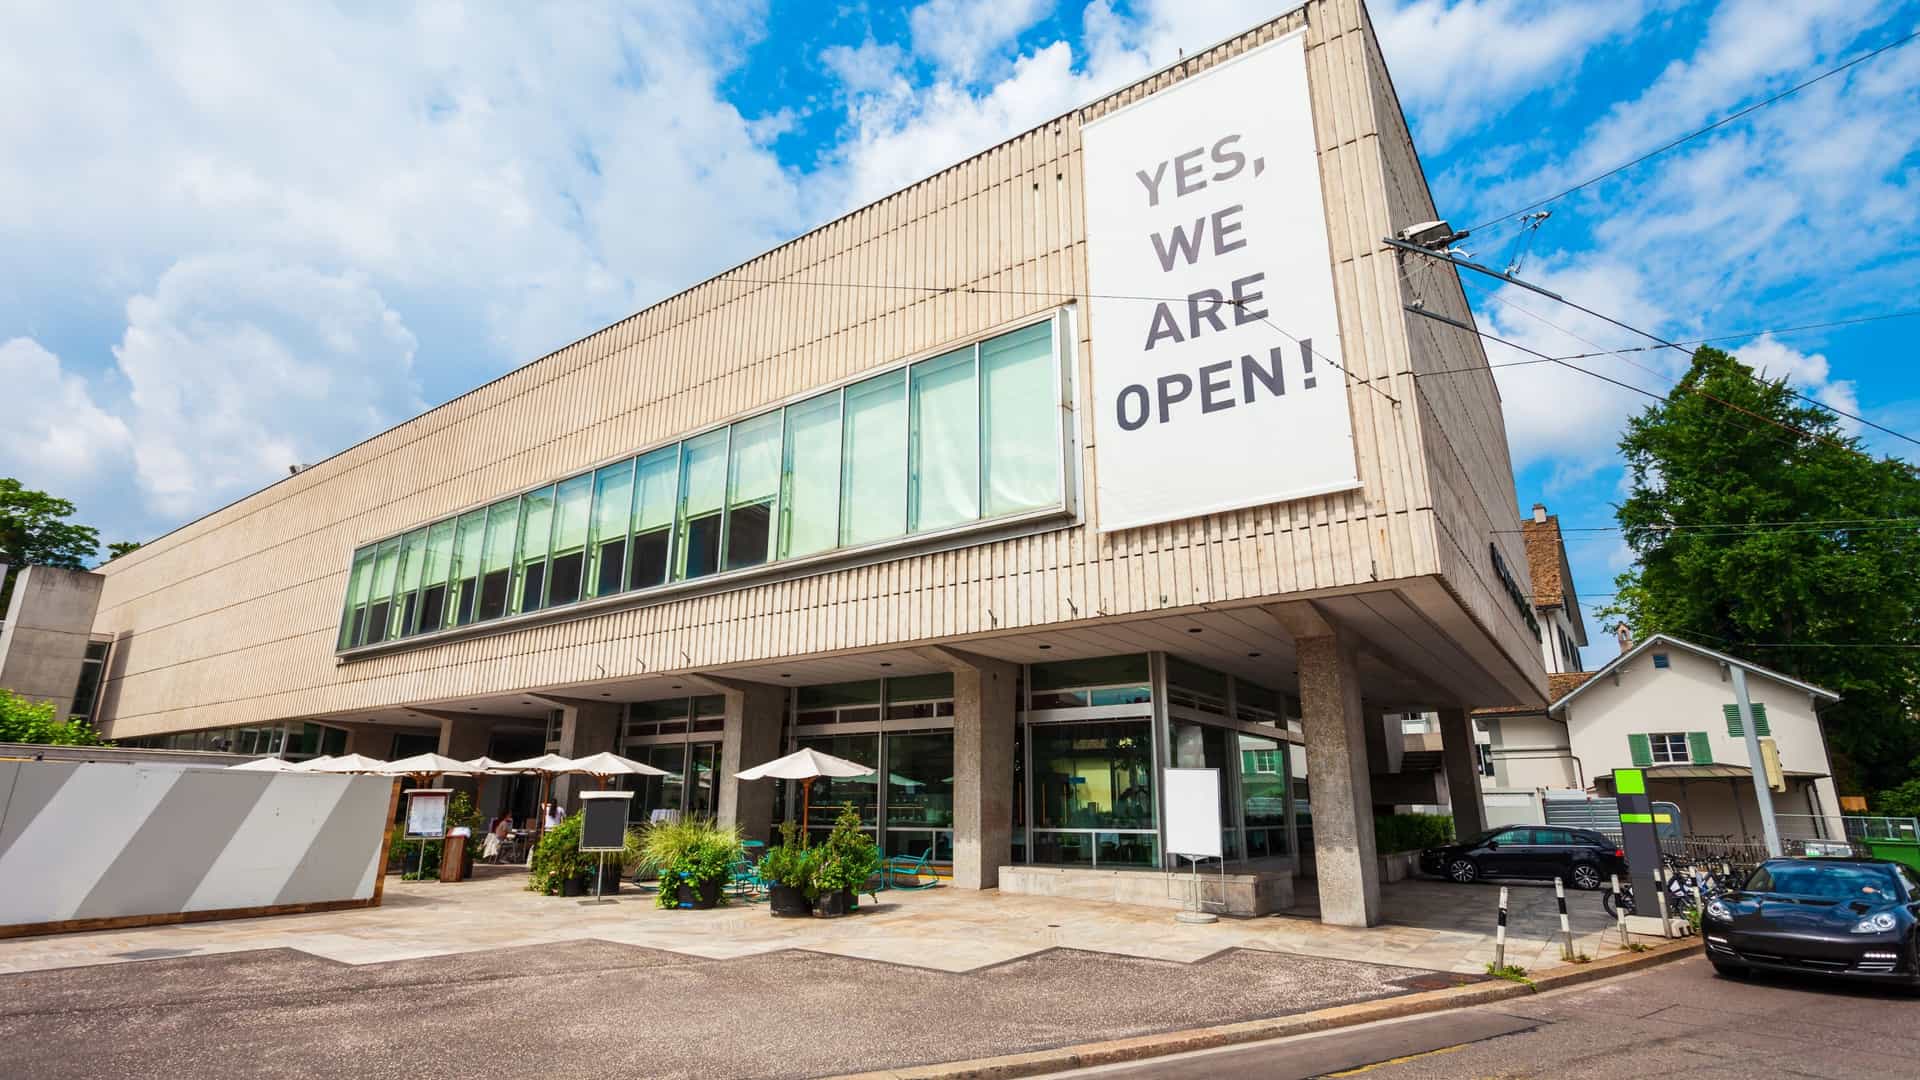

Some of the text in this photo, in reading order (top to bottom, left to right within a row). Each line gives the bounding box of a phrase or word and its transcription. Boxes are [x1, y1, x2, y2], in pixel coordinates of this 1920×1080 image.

[1135, 134, 1265, 207] YES,
[1150, 204, 1248, 273] WE
[1143, 271, 1269, 352] ARE
